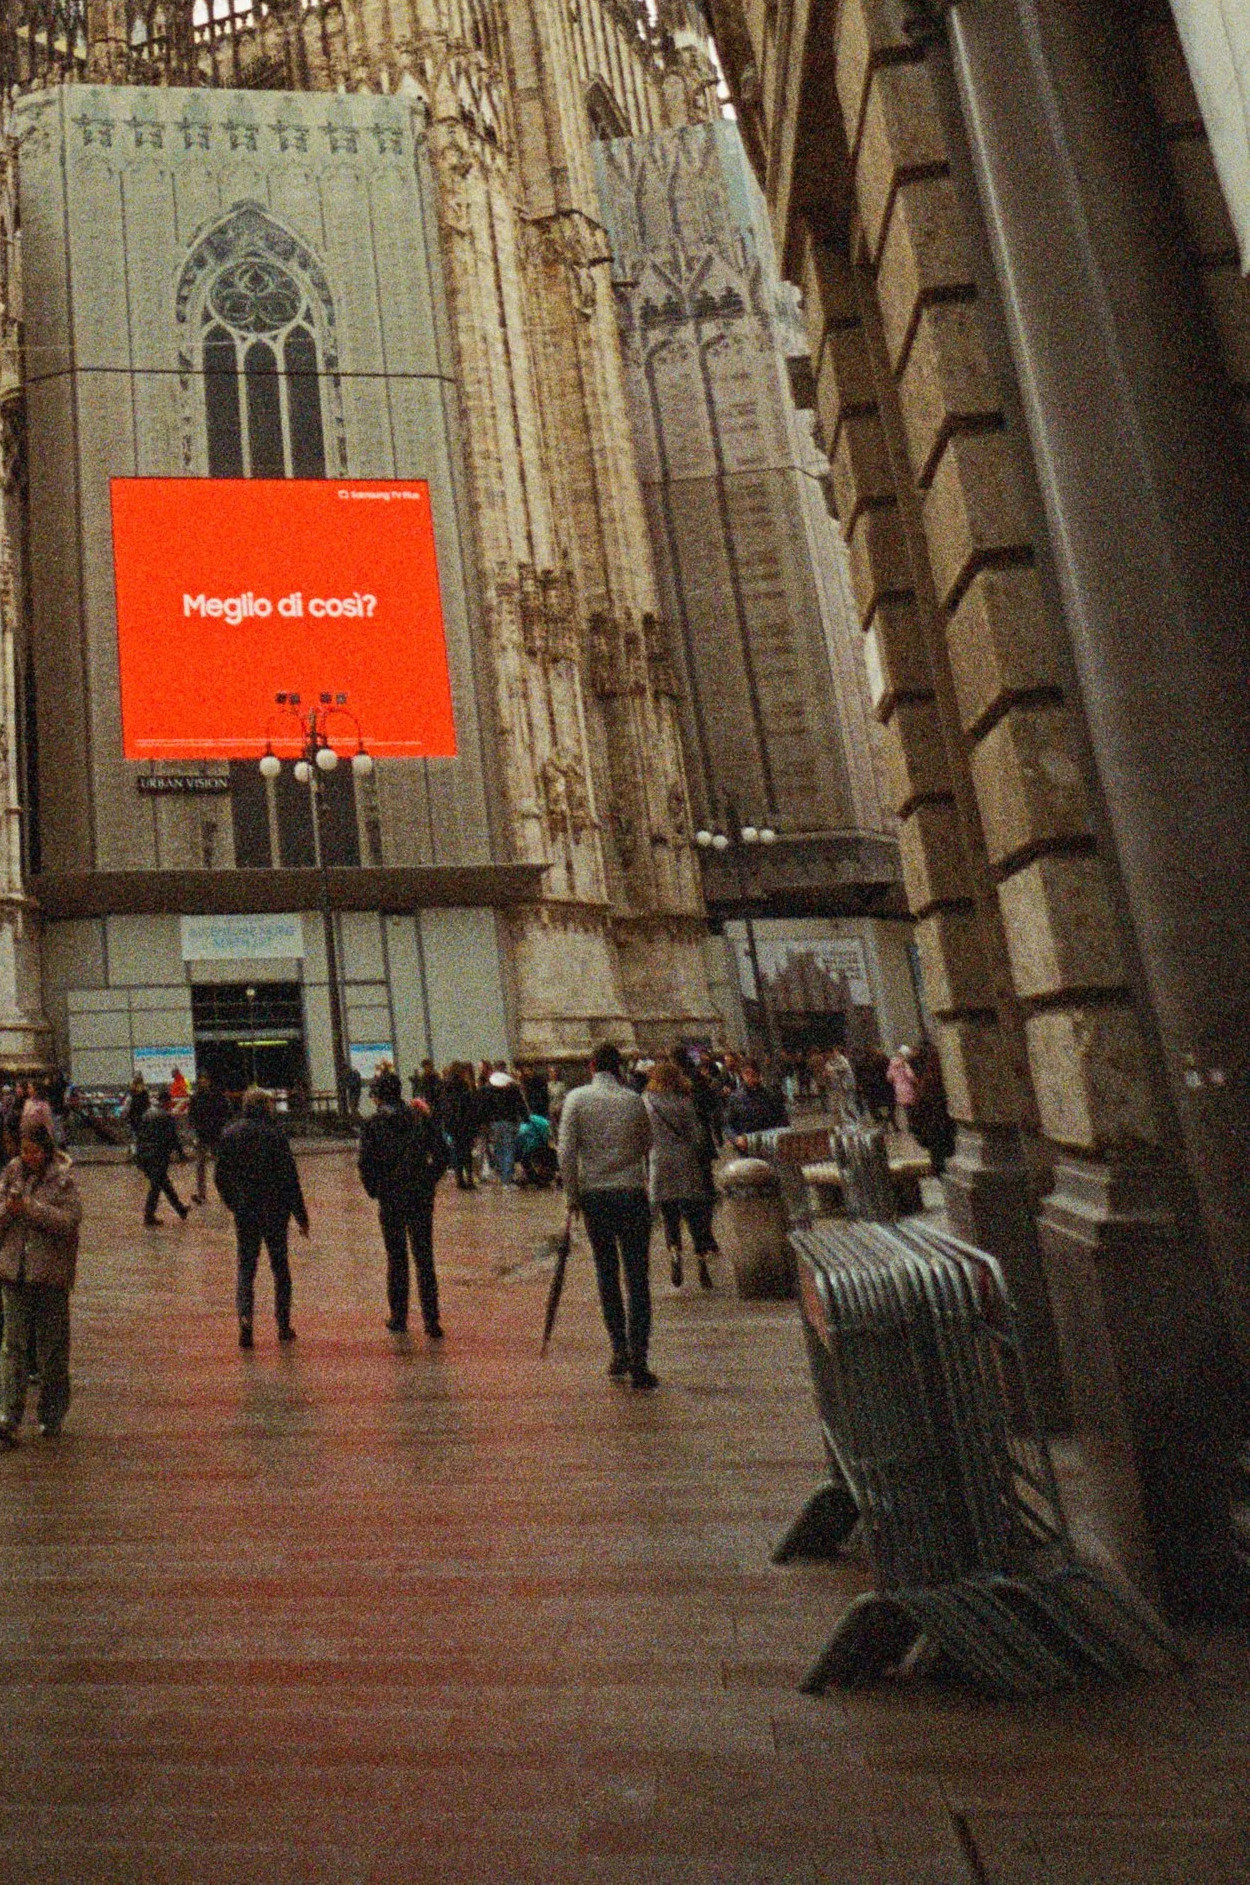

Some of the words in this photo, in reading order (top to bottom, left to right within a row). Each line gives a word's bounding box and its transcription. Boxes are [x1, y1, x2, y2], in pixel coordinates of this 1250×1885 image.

[350, 490, 390, 502] Samsung
[183, 592, 272, 626] Meglio
[278, 592, 303, 618] di
[308, 591, 378, 618] così?
[140, 778, 183, 788] URBAN
[186, 778, 228, 788] VISION
